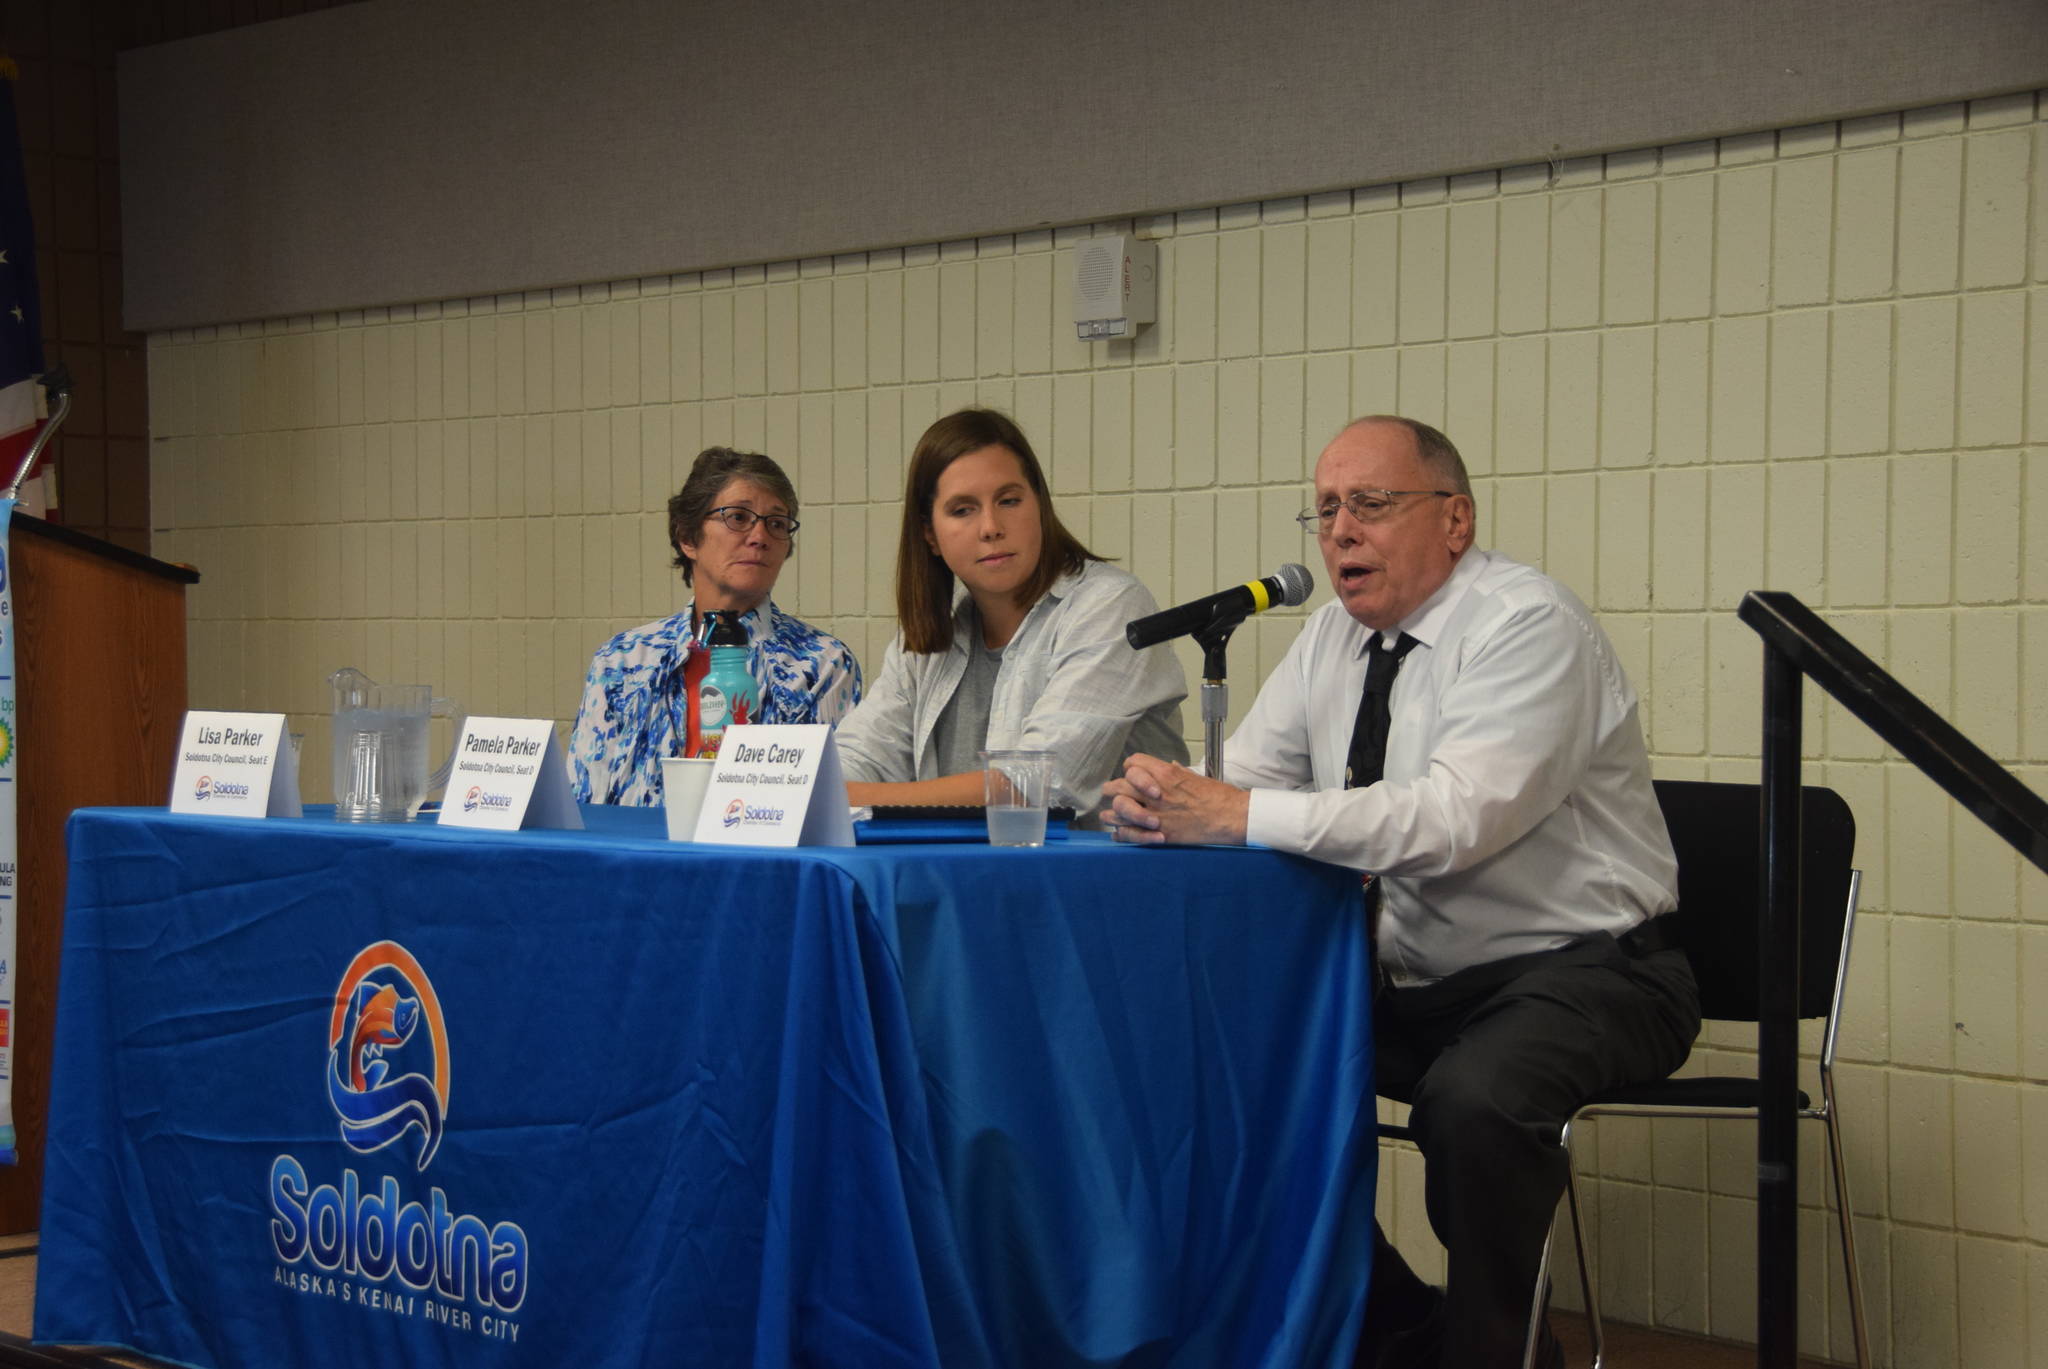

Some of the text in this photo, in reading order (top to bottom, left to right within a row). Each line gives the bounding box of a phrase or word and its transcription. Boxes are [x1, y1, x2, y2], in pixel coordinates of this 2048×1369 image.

[198, 727, 263, 746] Lisa Parker
[465, 734, 541, 756] Pamela Parker
[185, 752, 211, 763] Soldotna
[212, 754, 223, 765] City
[248, 755, 263, 765] Seat
[734, 744, 805, 768] Dave Carey
[459, 761, 483, 772] Soldotna
[483, 762, 495, 774] City
[515, 765, 529, 775] Seat
[716, 772, 745, 783] Soldotna
[745, 773, 759, 786] City
[786, 774, 803, 785] Seat
[802, 774, 808, 785] D
[213, 782, 249, 795] Soldotna
[481, 792, 512, 806] Soldotna
[744, 805, 784, 821] Soldotna
[270, 1153, 529, 1313] Soldotna
[274, 1265, 520, 1344] ALASKA'S KENAI RIVER CITY
